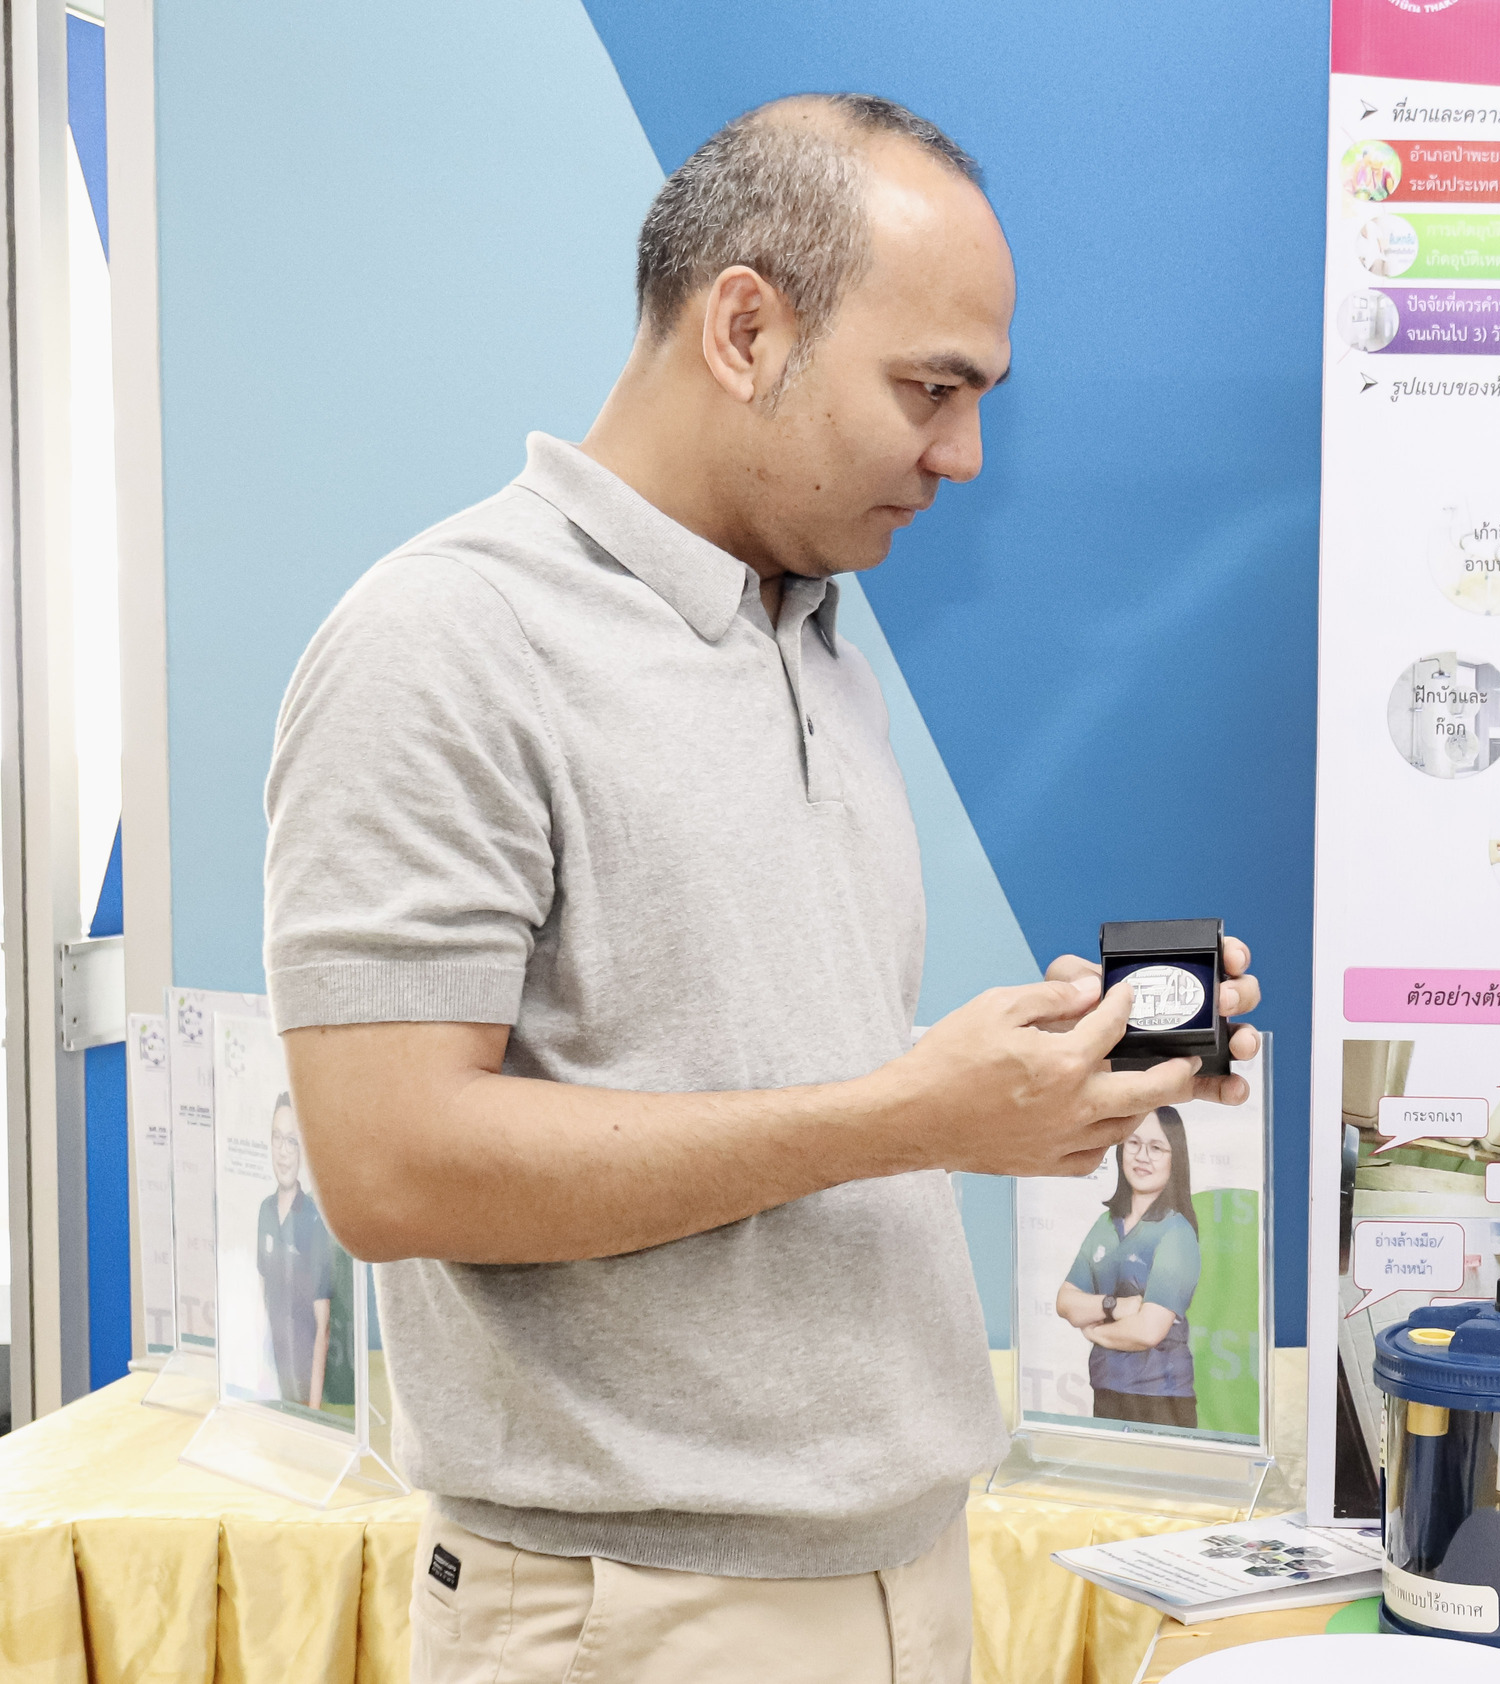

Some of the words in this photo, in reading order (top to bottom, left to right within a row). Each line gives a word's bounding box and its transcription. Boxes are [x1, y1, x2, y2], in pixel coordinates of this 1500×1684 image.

[1408, 173, 1499, 193] ระดับประเทศ
[1406, 323, 1468, 343] จนเกินไป
[1472, 327, 1487, 344] 3)
[1414, 684, 1489, 706] ฝักบัวและ
[1435, 716, 1467, 736] ก๊อก
[1403, 1108, 1464, 1123] กระจกเงา
[1384, 1258, 1433, 1278] ล้างหน้า
